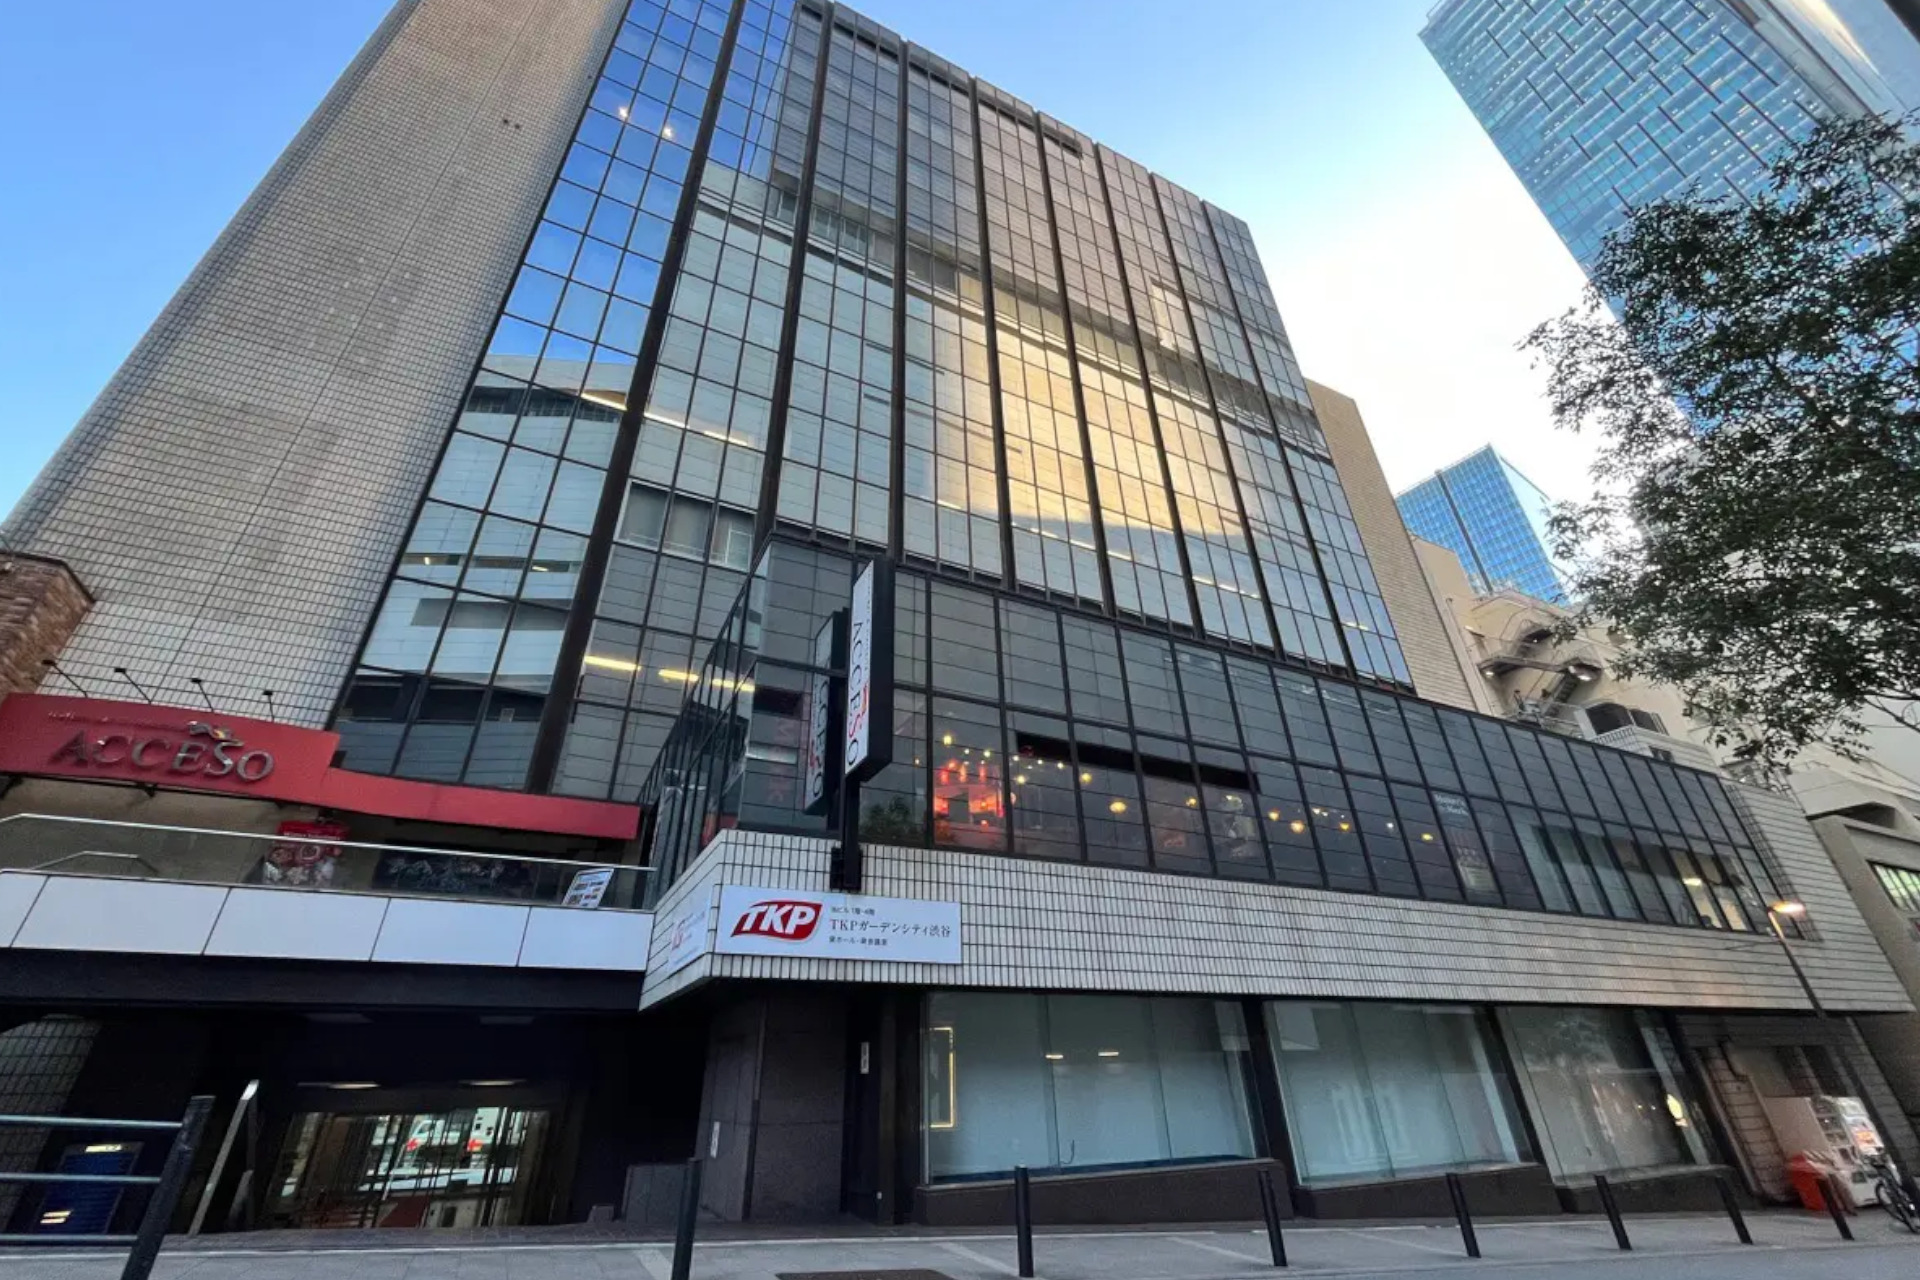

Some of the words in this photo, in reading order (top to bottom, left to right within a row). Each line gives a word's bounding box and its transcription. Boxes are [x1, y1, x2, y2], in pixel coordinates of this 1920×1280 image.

[848, 621, 863, 766] ACCESO
[48, 730, 274, 782] ACCESO
[741, 903, 817, 935] TKP
[830, 919, 951, 938] TKPガーデンシティ渋谷
